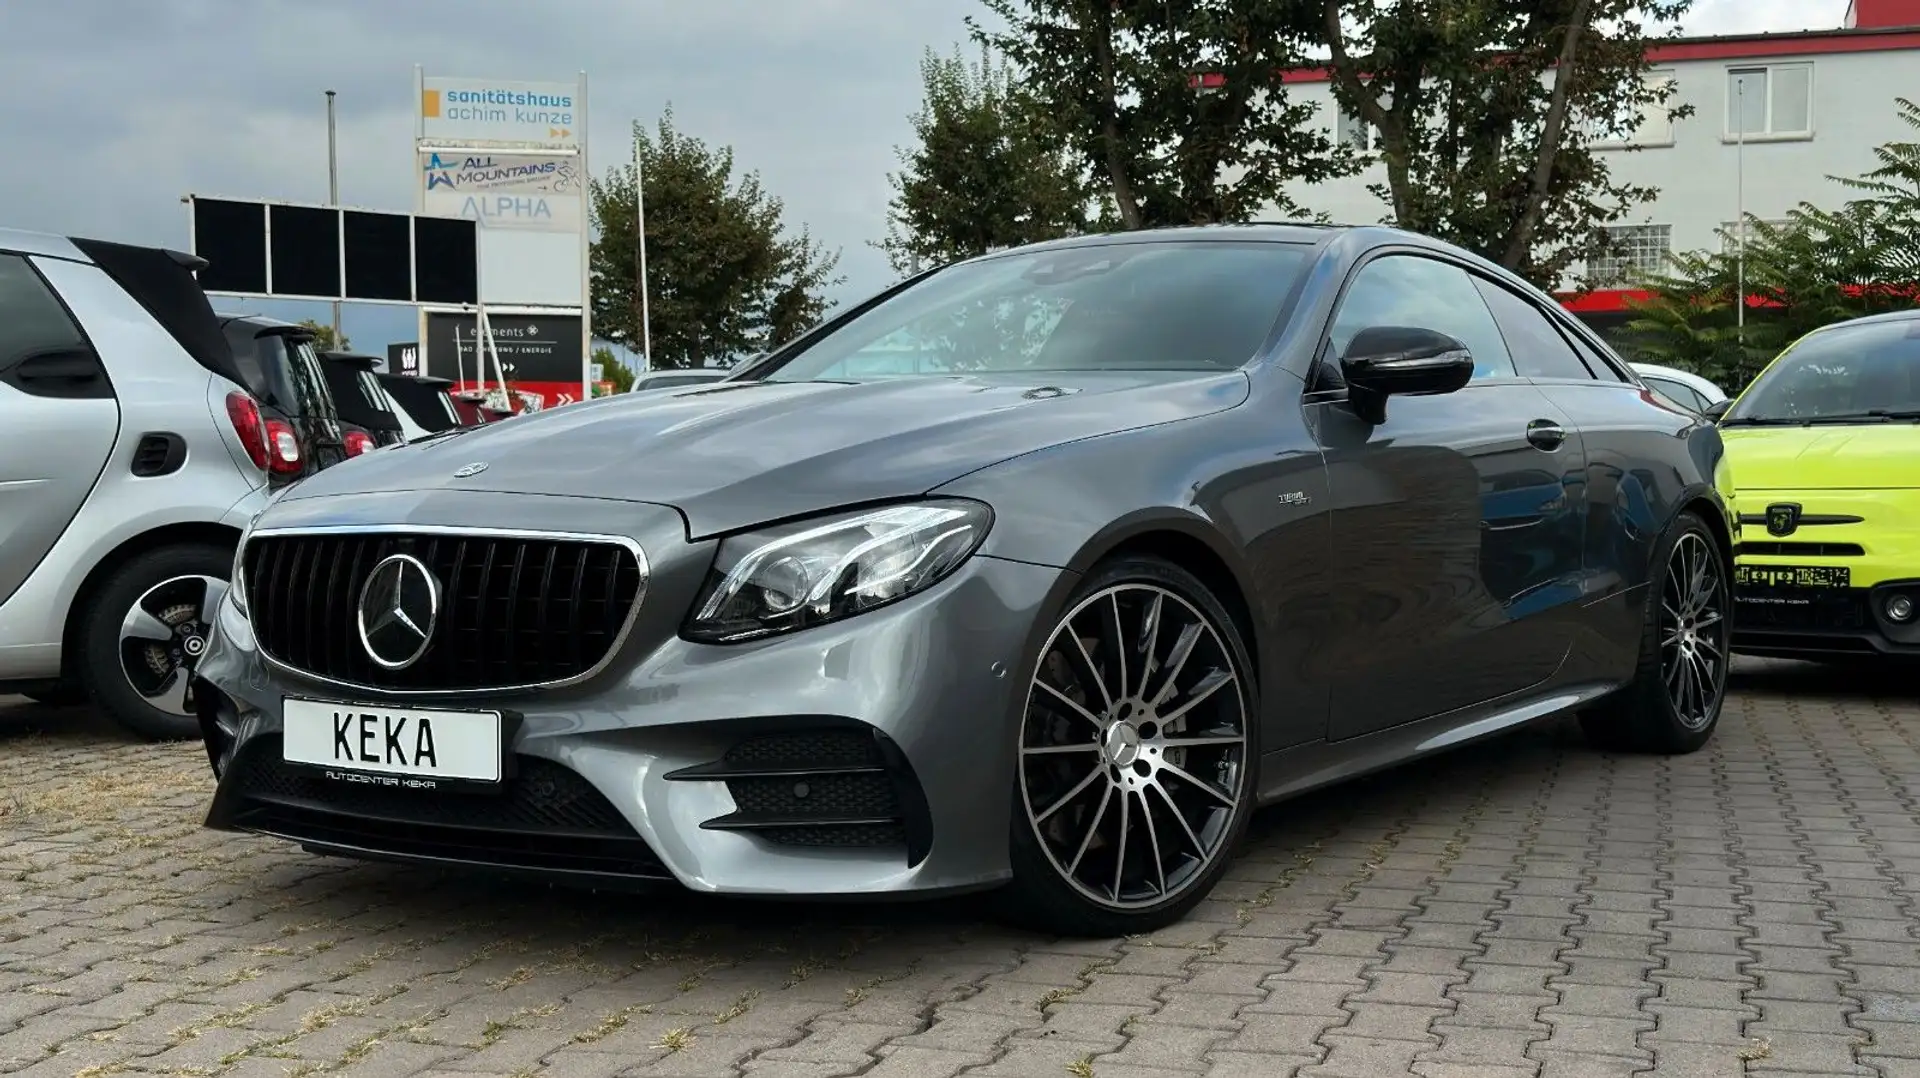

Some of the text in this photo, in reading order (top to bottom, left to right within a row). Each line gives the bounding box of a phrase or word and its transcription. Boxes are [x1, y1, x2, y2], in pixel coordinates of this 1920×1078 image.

[447, 89, 572, 108] sanitätshaus
[447, 106, 572, 125] achim kunze
[462, 156, 498, 171] ALL
[456, 162, 556, 185] MOUNTAINS
[461, 196, 552, 219] ALPHA
[333, 712, 437, 767] KEKA
[326, 771, 436, 789] AUTOCENTER KEKA
